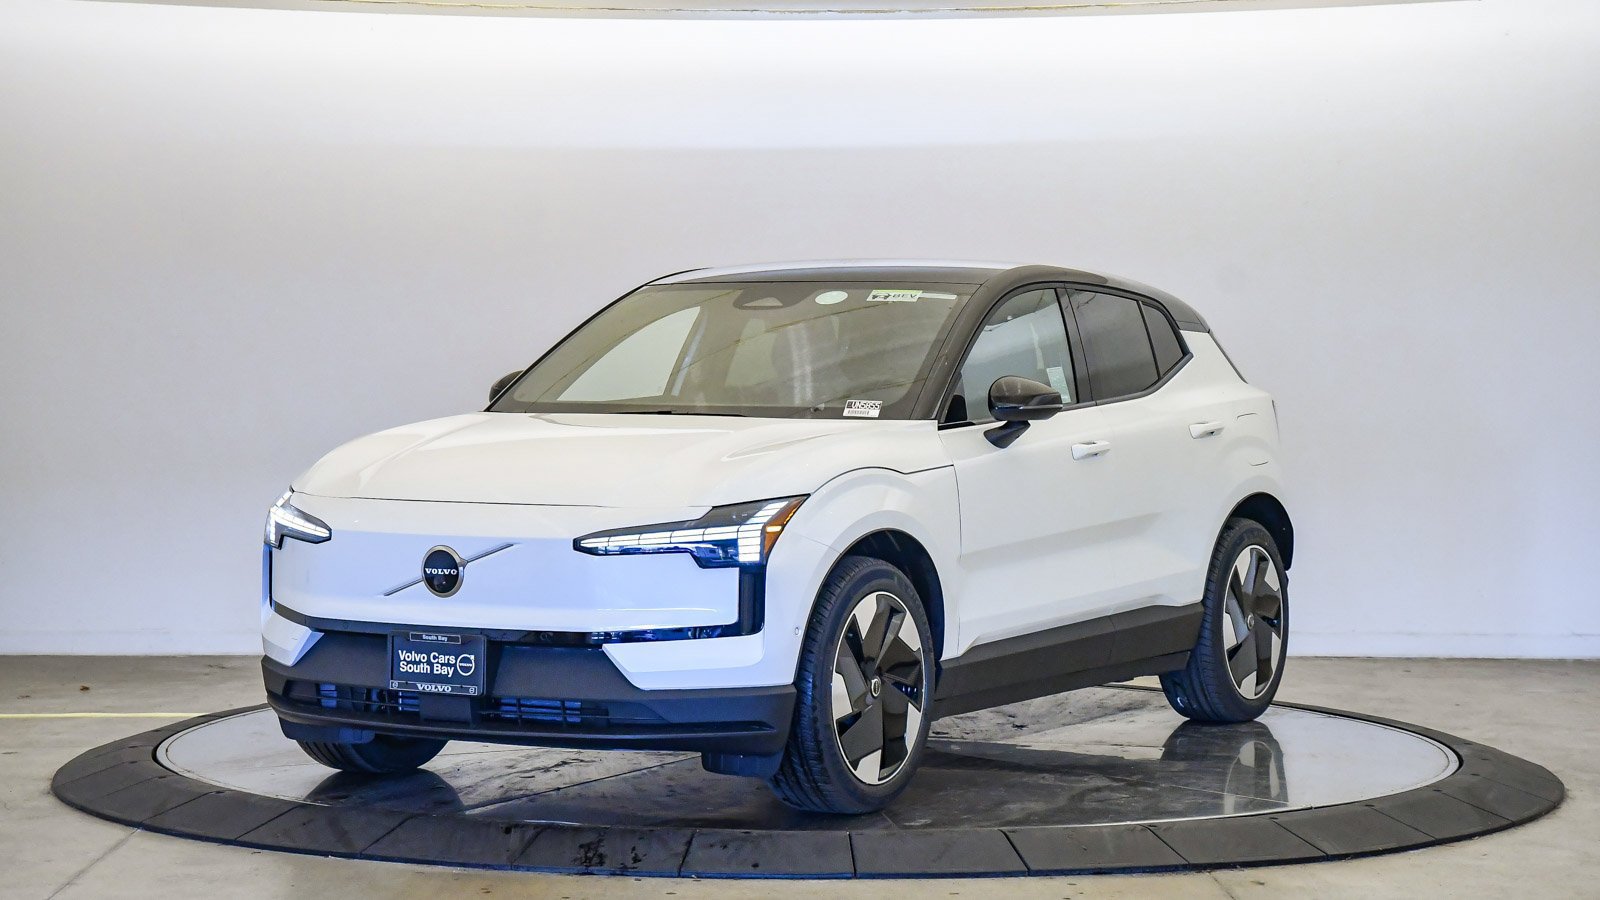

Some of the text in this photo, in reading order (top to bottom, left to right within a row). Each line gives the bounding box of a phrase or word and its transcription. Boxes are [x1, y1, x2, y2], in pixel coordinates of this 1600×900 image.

[425, 567, 457, 575] VOLVO
[398, 650, 456, 664] Volvo Cars
[400, 661, 454, 677] South Bay
[416, 683, 452, 693] VOLVO
